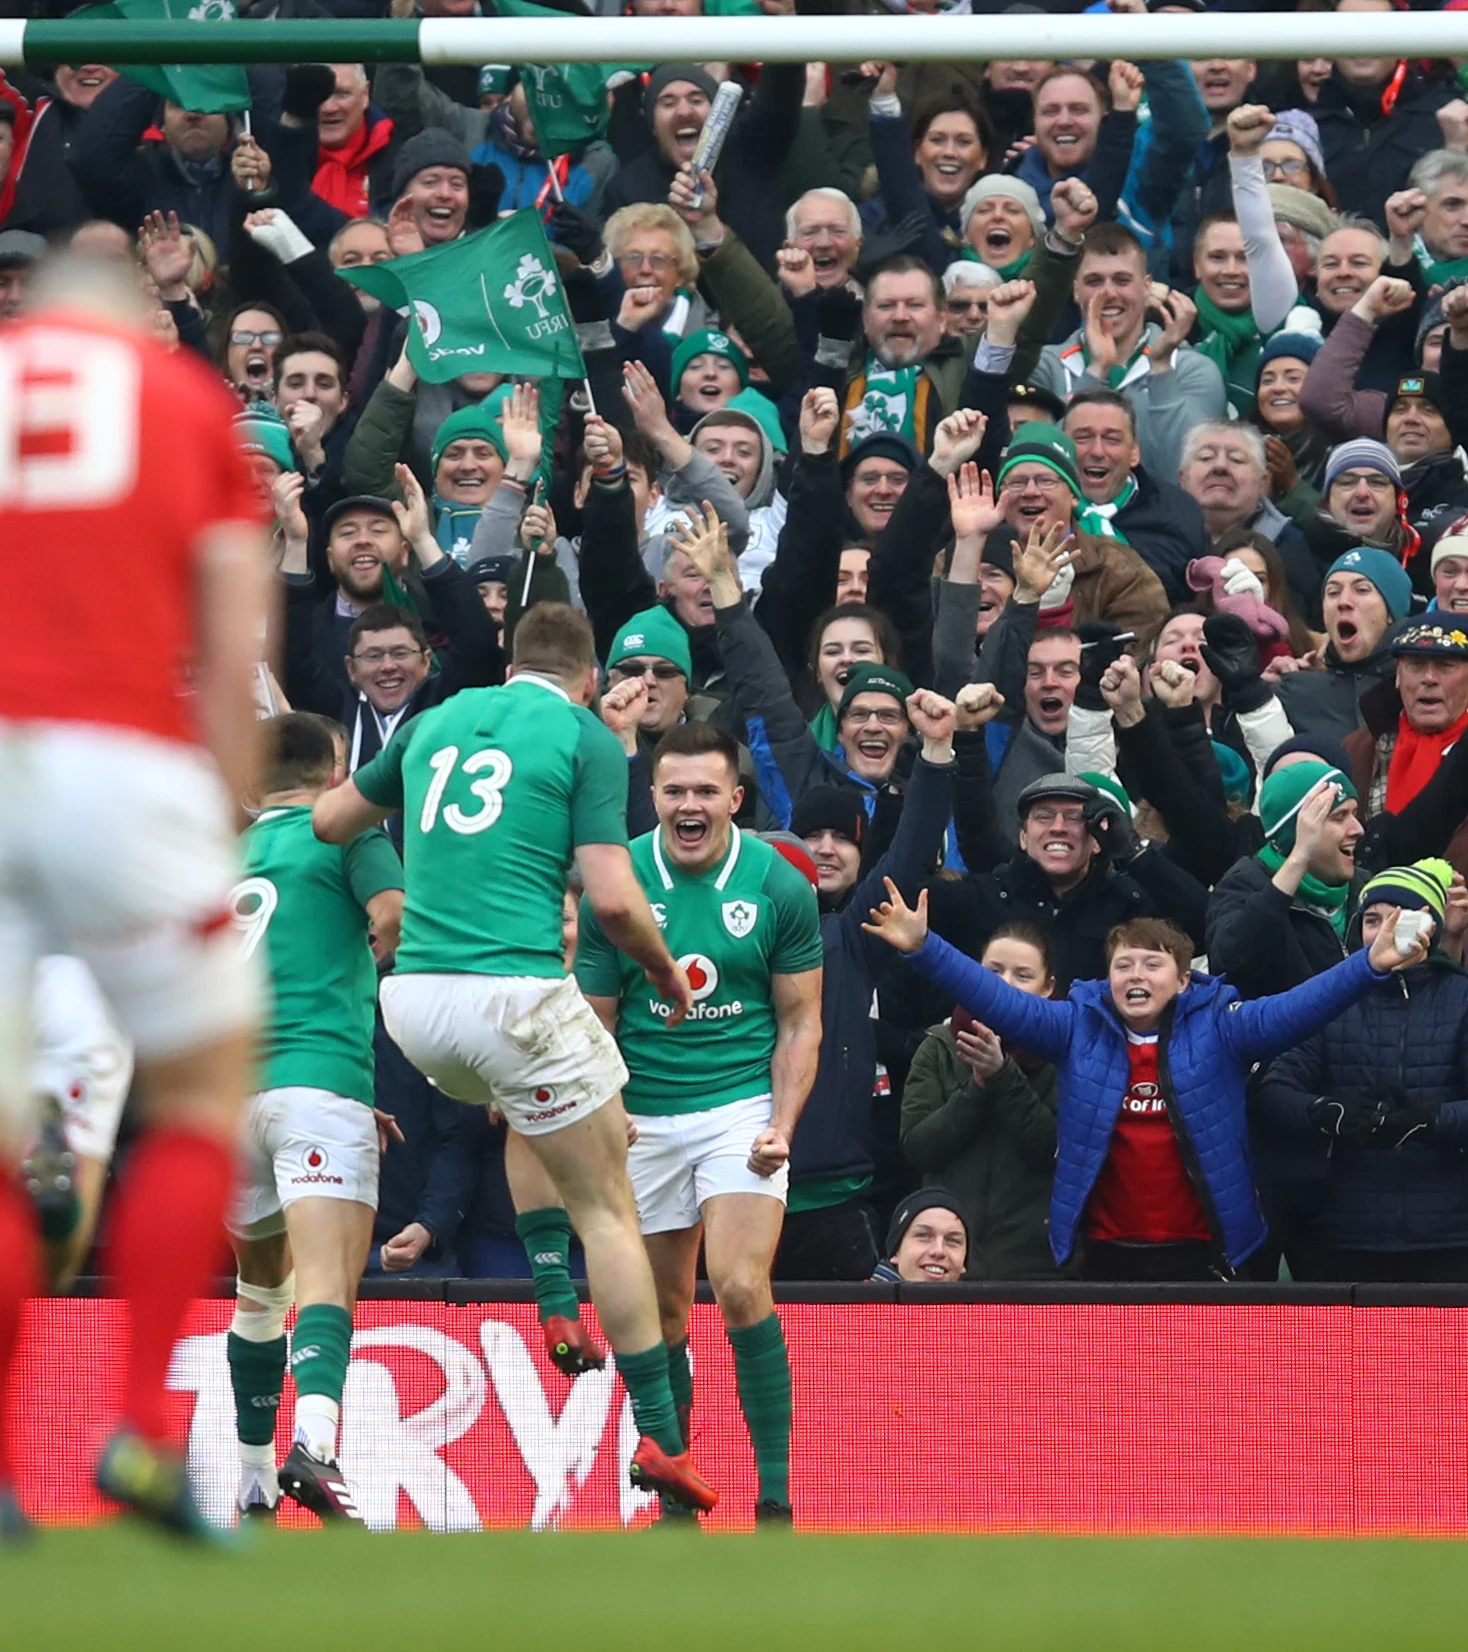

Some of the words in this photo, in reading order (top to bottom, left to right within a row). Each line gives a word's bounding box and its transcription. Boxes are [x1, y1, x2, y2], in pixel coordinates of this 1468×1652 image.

[420, 745, 513, 836] 13
[649, 998, 743, 1020] voafone
[291, 1172, 344, 1185] vodafone
